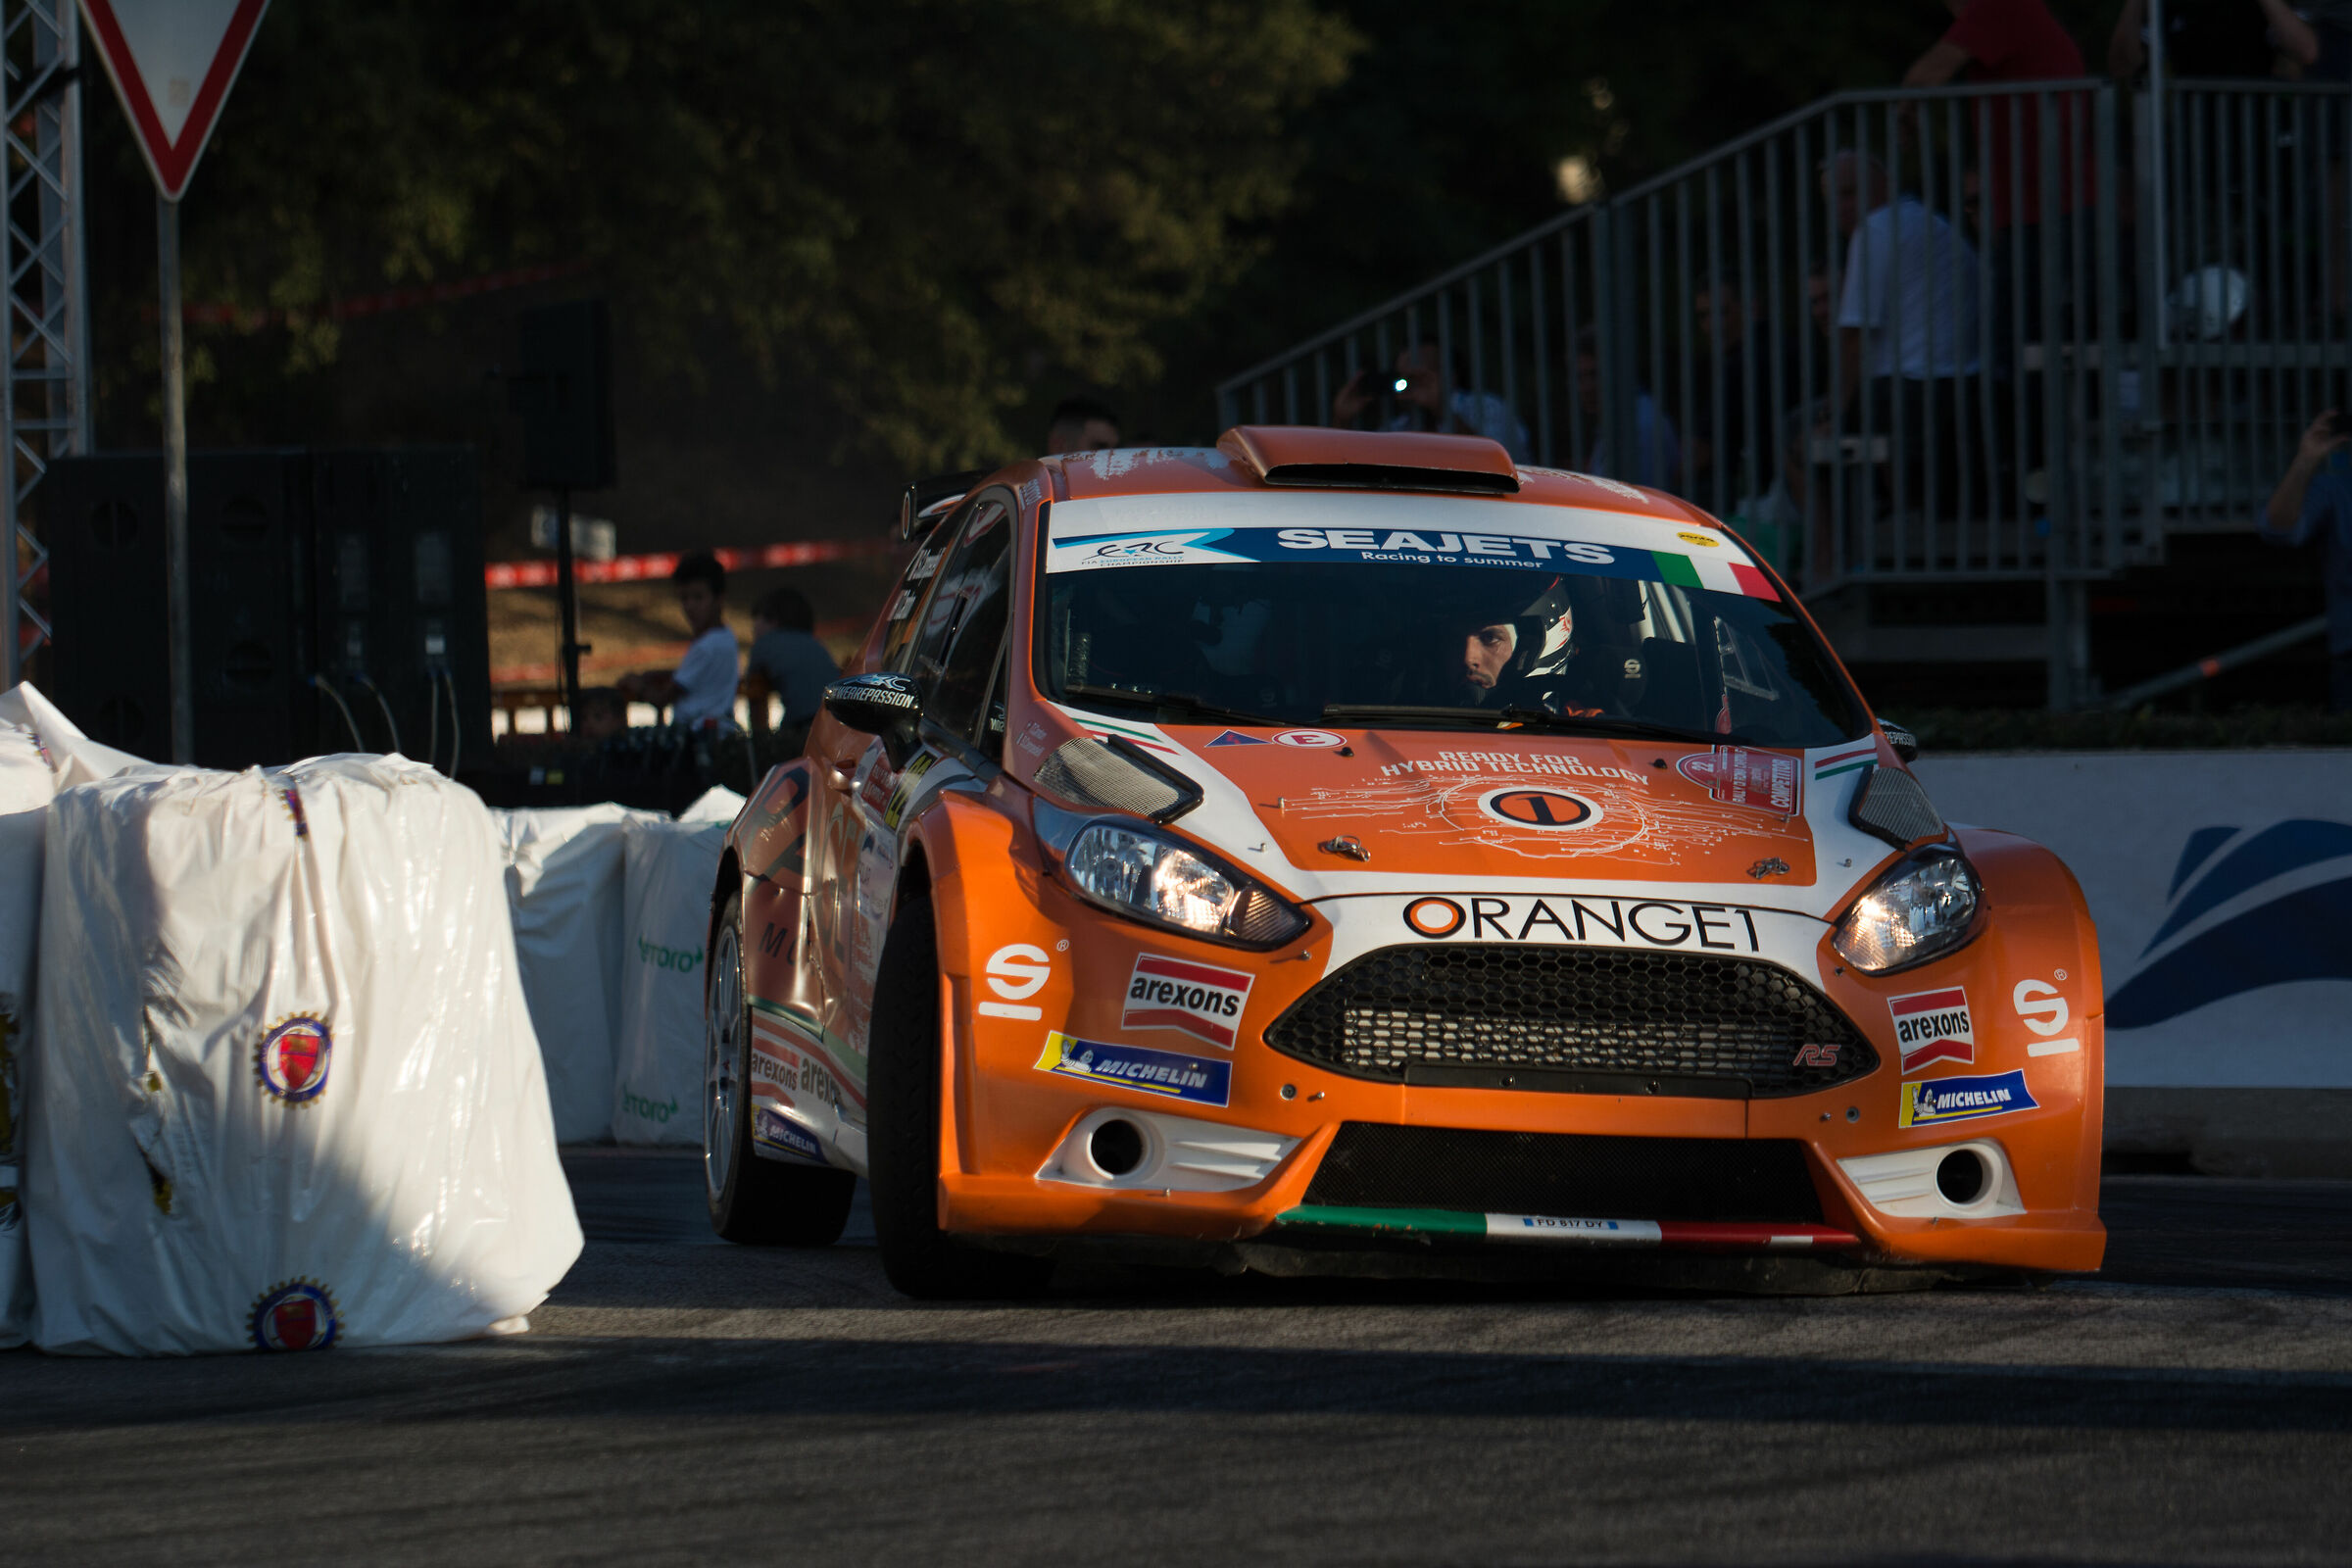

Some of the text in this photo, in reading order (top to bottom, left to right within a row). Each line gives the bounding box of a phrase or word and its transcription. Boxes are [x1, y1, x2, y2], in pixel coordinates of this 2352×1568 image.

[1277, 529, 1615, 565] SEAJETS
[1361, 551, 1431, 564] Racing
[1464, 558, 1544, 568] summer
[1380, 760, 1648, 785] HYBRID TECHNOLOGY
[1438, 751, 1583, 766] READY FOR
[1770, 759, 1790, 808] COMPETITOR
[1402, 896, 1760, 953] ORANGE1
[1130, 977, 1241, 1017] arexons
[1898, 1010, 1970, 1043] arexons
[1793, 1044, 1841, 1066] RS
[752, 1053, 798, 1091] arexons
[1096, 1058, 1207, 1088] MICHELIN
[1936, 1088, 2012, 1109] MICHELIN
[769, 1125, 816, 1155] MICHELIN
